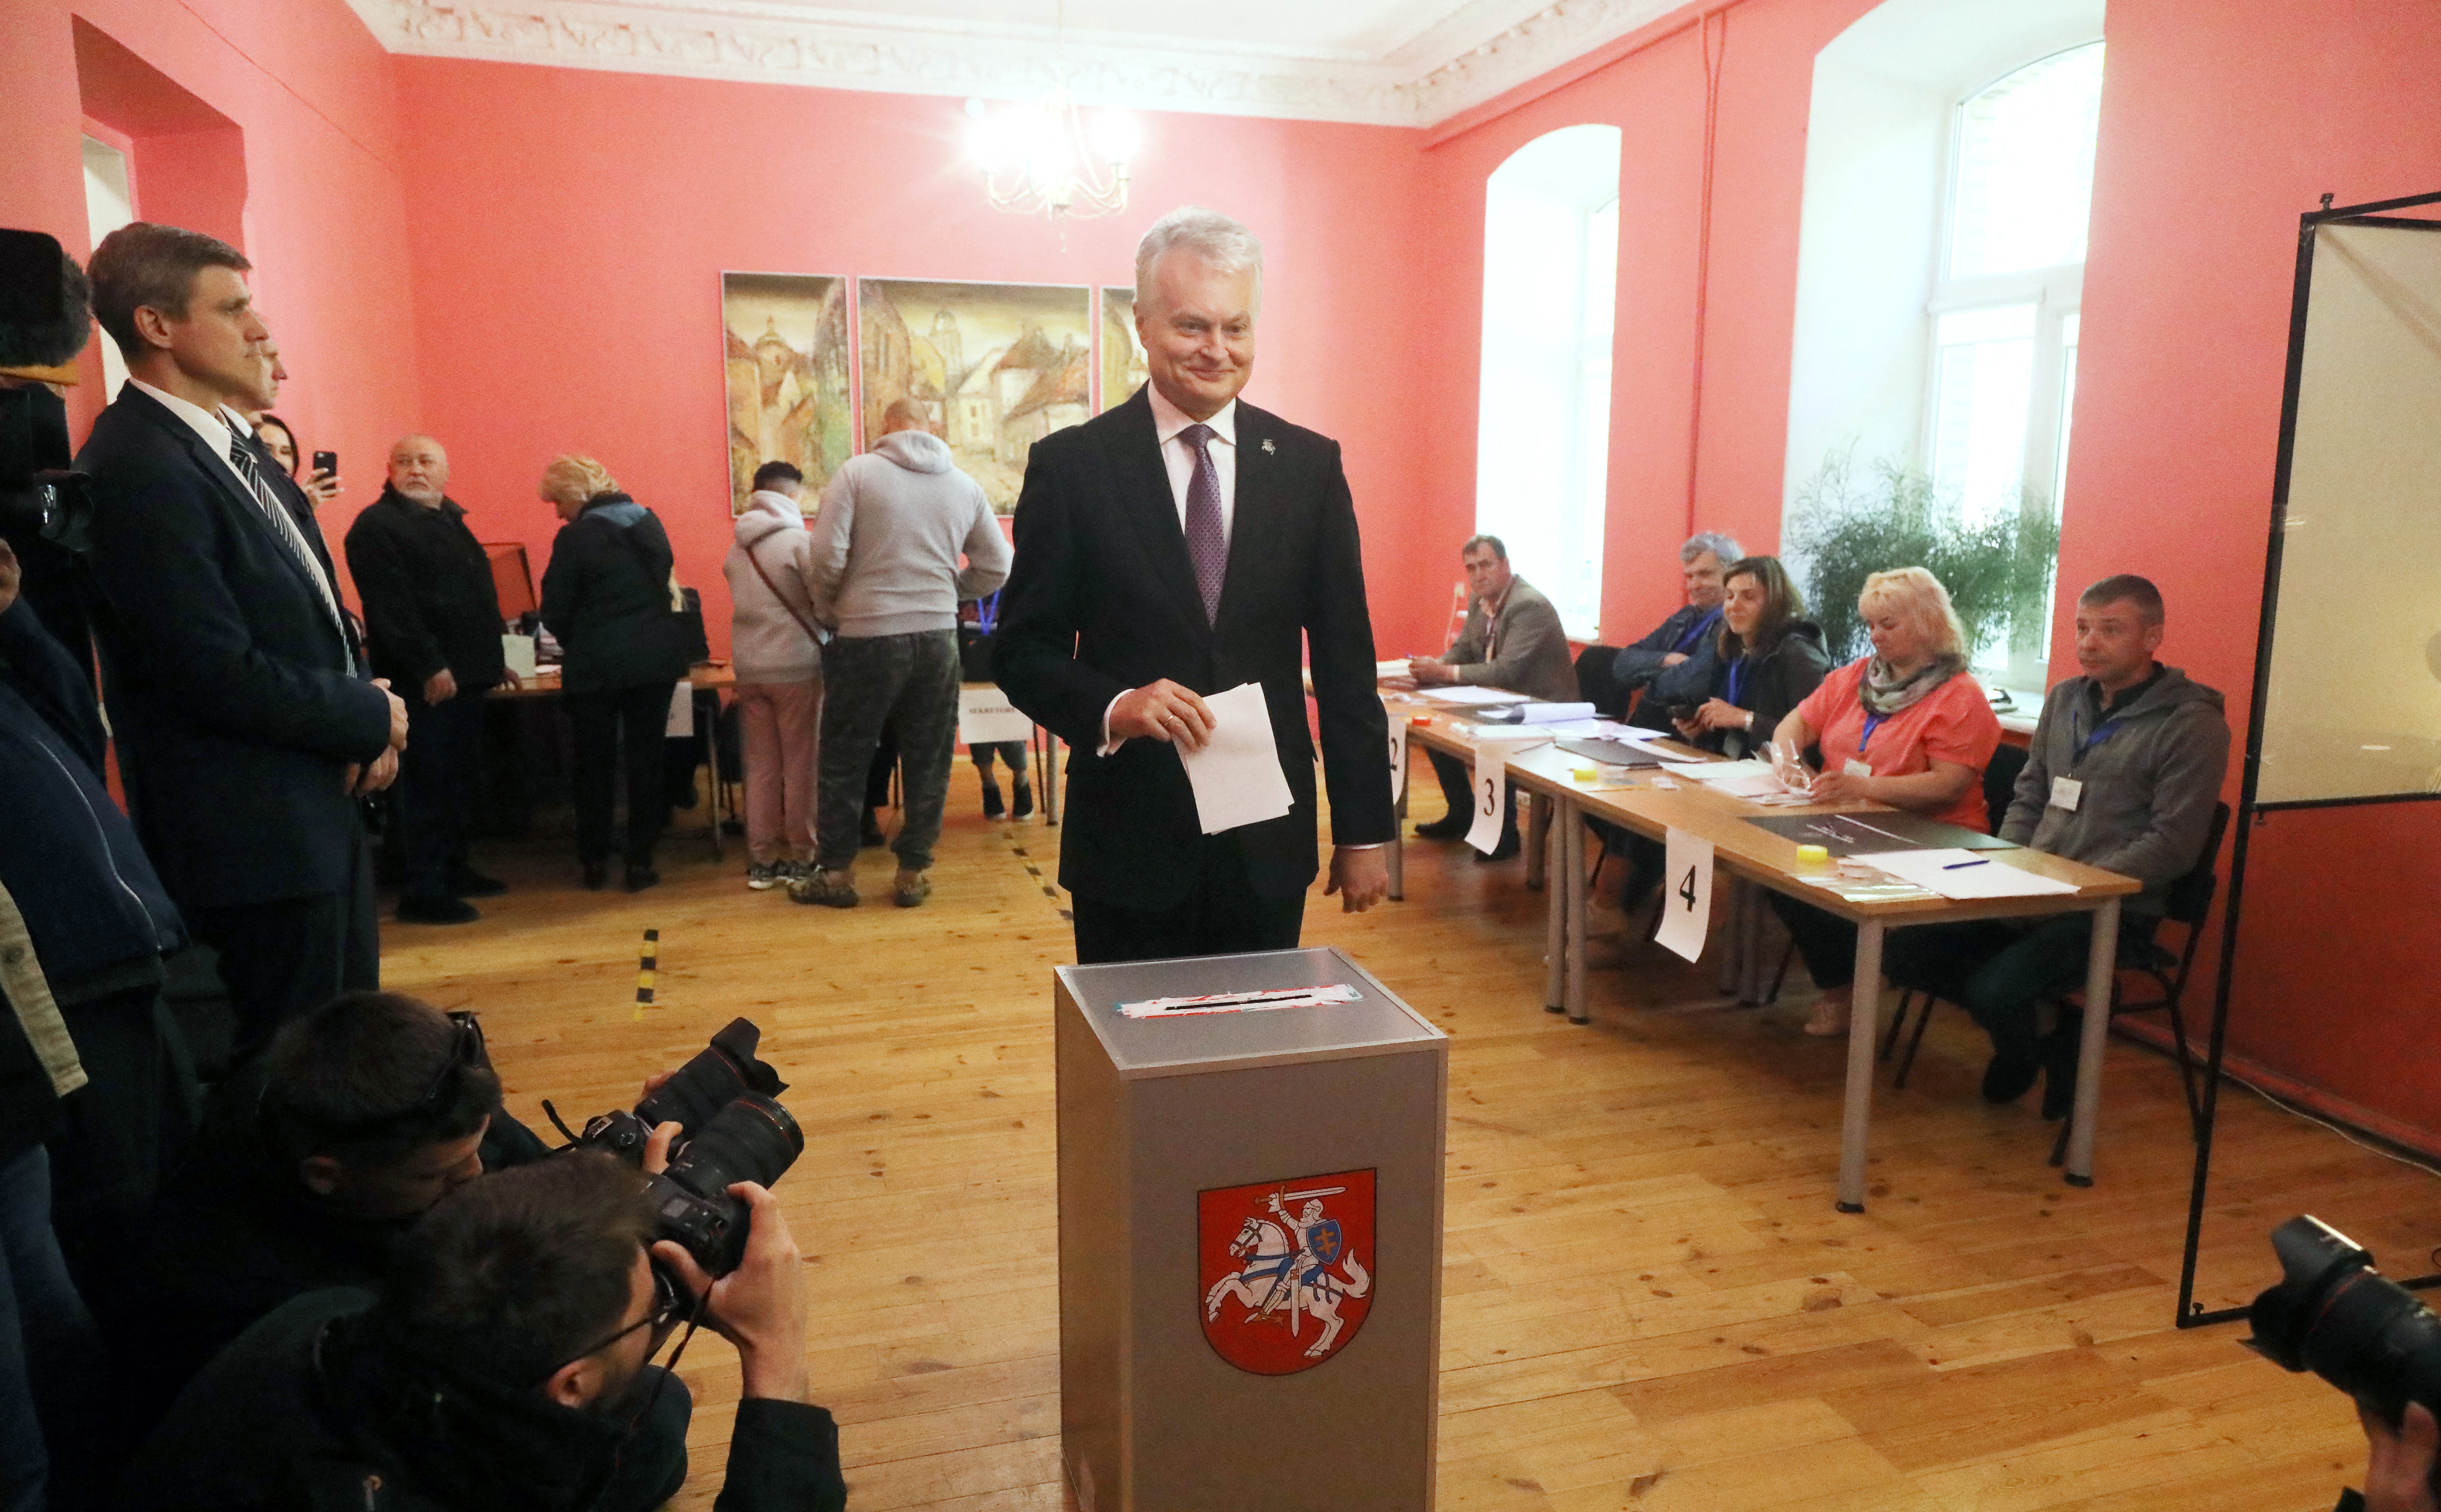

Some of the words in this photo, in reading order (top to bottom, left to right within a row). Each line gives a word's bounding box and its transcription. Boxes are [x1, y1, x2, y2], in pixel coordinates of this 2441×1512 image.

[1390, 737, 1398, 771] 2
[1484, 778, 1495, 816] 3
[1680, 865, 1696, 913] 4
